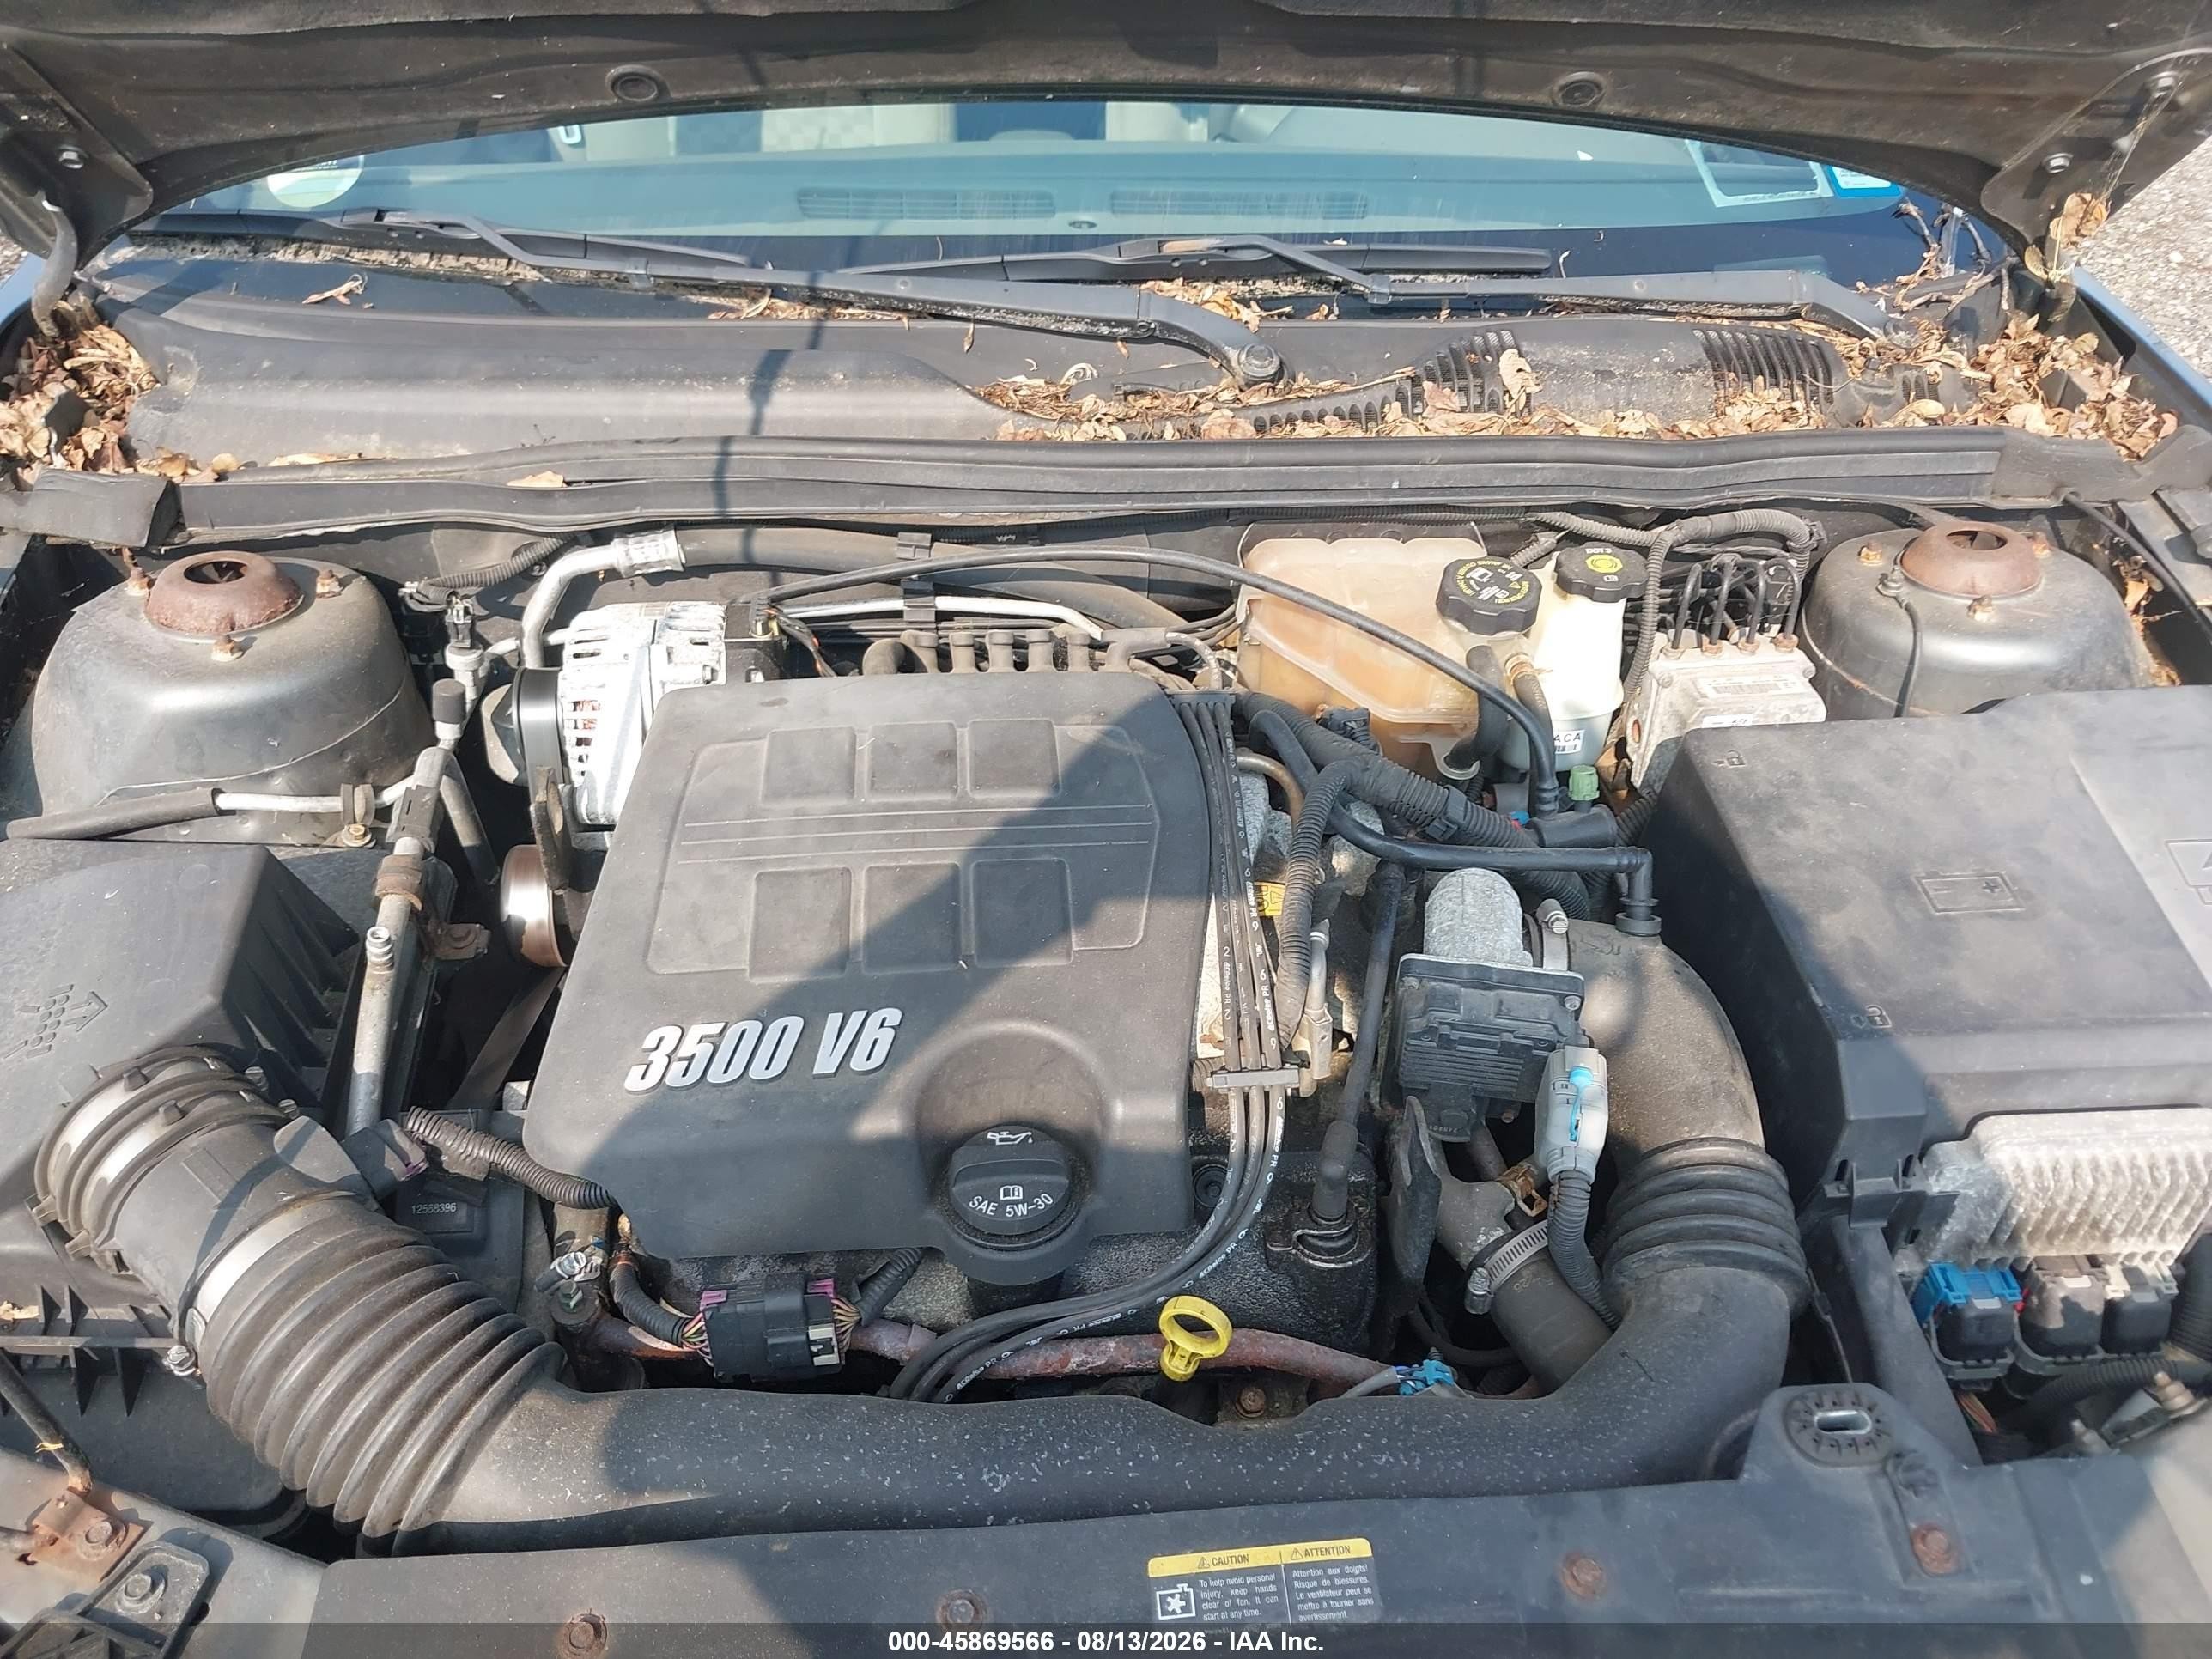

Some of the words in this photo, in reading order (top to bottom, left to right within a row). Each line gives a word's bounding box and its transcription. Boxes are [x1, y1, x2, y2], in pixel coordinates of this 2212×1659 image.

[1224, 946, 1230, 957] 2
[623, 1015, 805, 1093] 3500
[812, 1007, 903, 1077] V6
[969, 1195, 998, 1216] SAE
[1006, 1193, 1054, 1218] 5W-30
[1304, 1545, 1351, 1558] ATTENTION
[1212, 1553, 1249, 1567] CAUTION
[1292, 1568, 1323, 1577] Attention
[1199, 1579, 1207, 1588] To
[1209, 1577, 1224, 1588] help
[1246, 1573, 1276, 1585] personal
[1294, 1579, 1317, 1589] Risque
[1230, 1587, 1248, 1596] keep
[1255, 1584, 1277, 1593] hands
[1307, 1588, 1343, 1599] ventilateur
[1346, 1586, 1361, 1596] peut
[1202, 1601, 1219, 1610] clear
[1224, 1599, 1232, 1607] of
[1266, 1595, 1279, 1604] can
[1297, 1601, 1320, 1611] mettre
[1330, 1599, 1354, 1608] tourner
[1203, 1612, 1219, 1621] start
[1221, 1611, 1228, 1620] at
[1230, 1611, 1243, 1620] any
